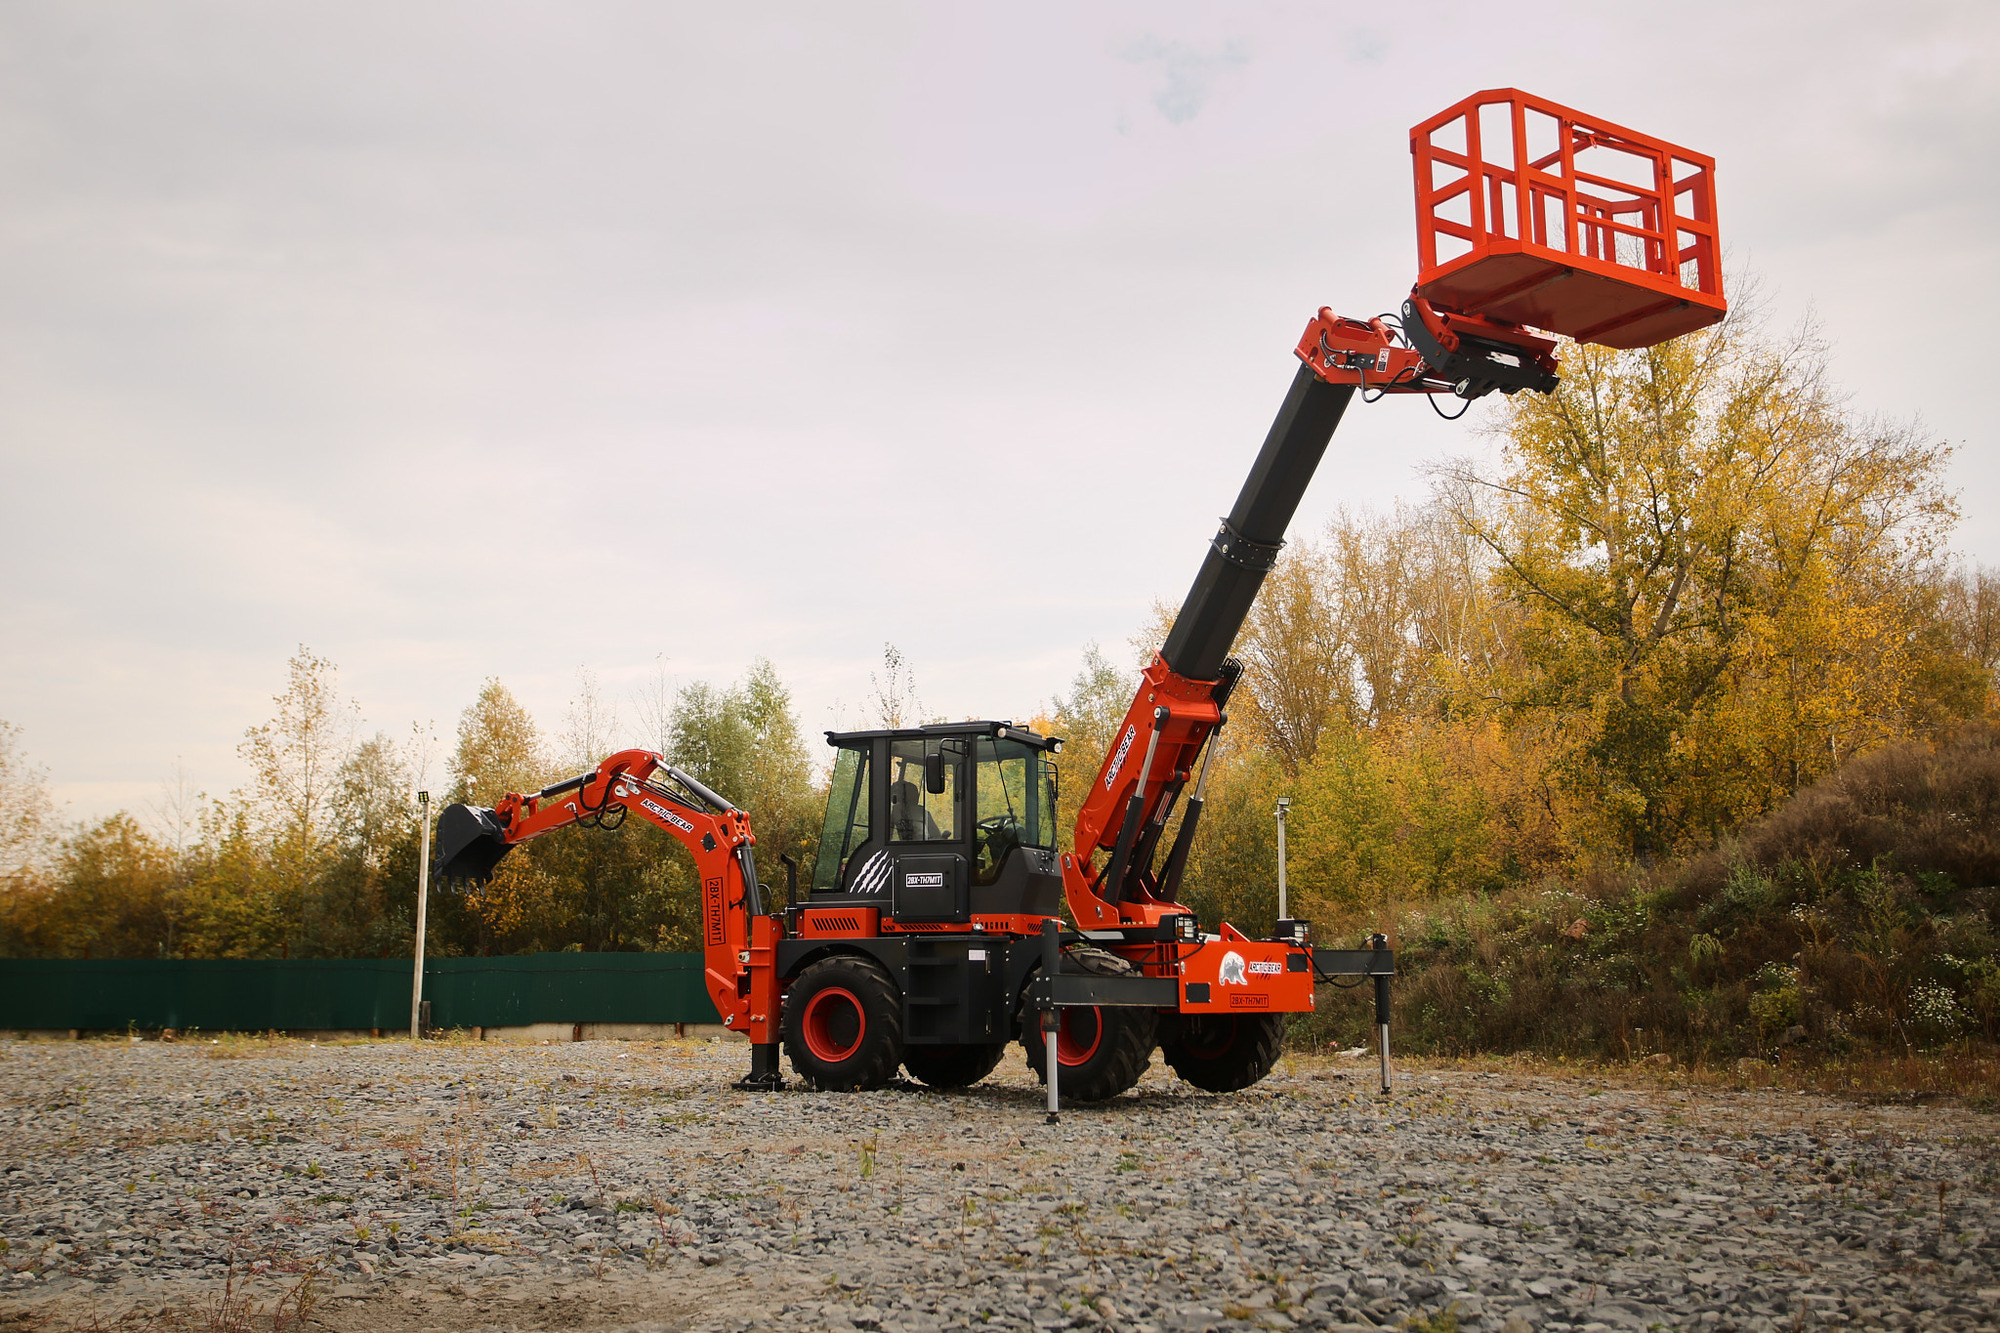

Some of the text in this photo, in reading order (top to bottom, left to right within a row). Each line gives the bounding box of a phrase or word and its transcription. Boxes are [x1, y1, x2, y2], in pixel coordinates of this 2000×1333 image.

[641, 799, 693, 832] ARCTIC BEAR
[709, 881, 722, 942] 2BX-TH7M1T
